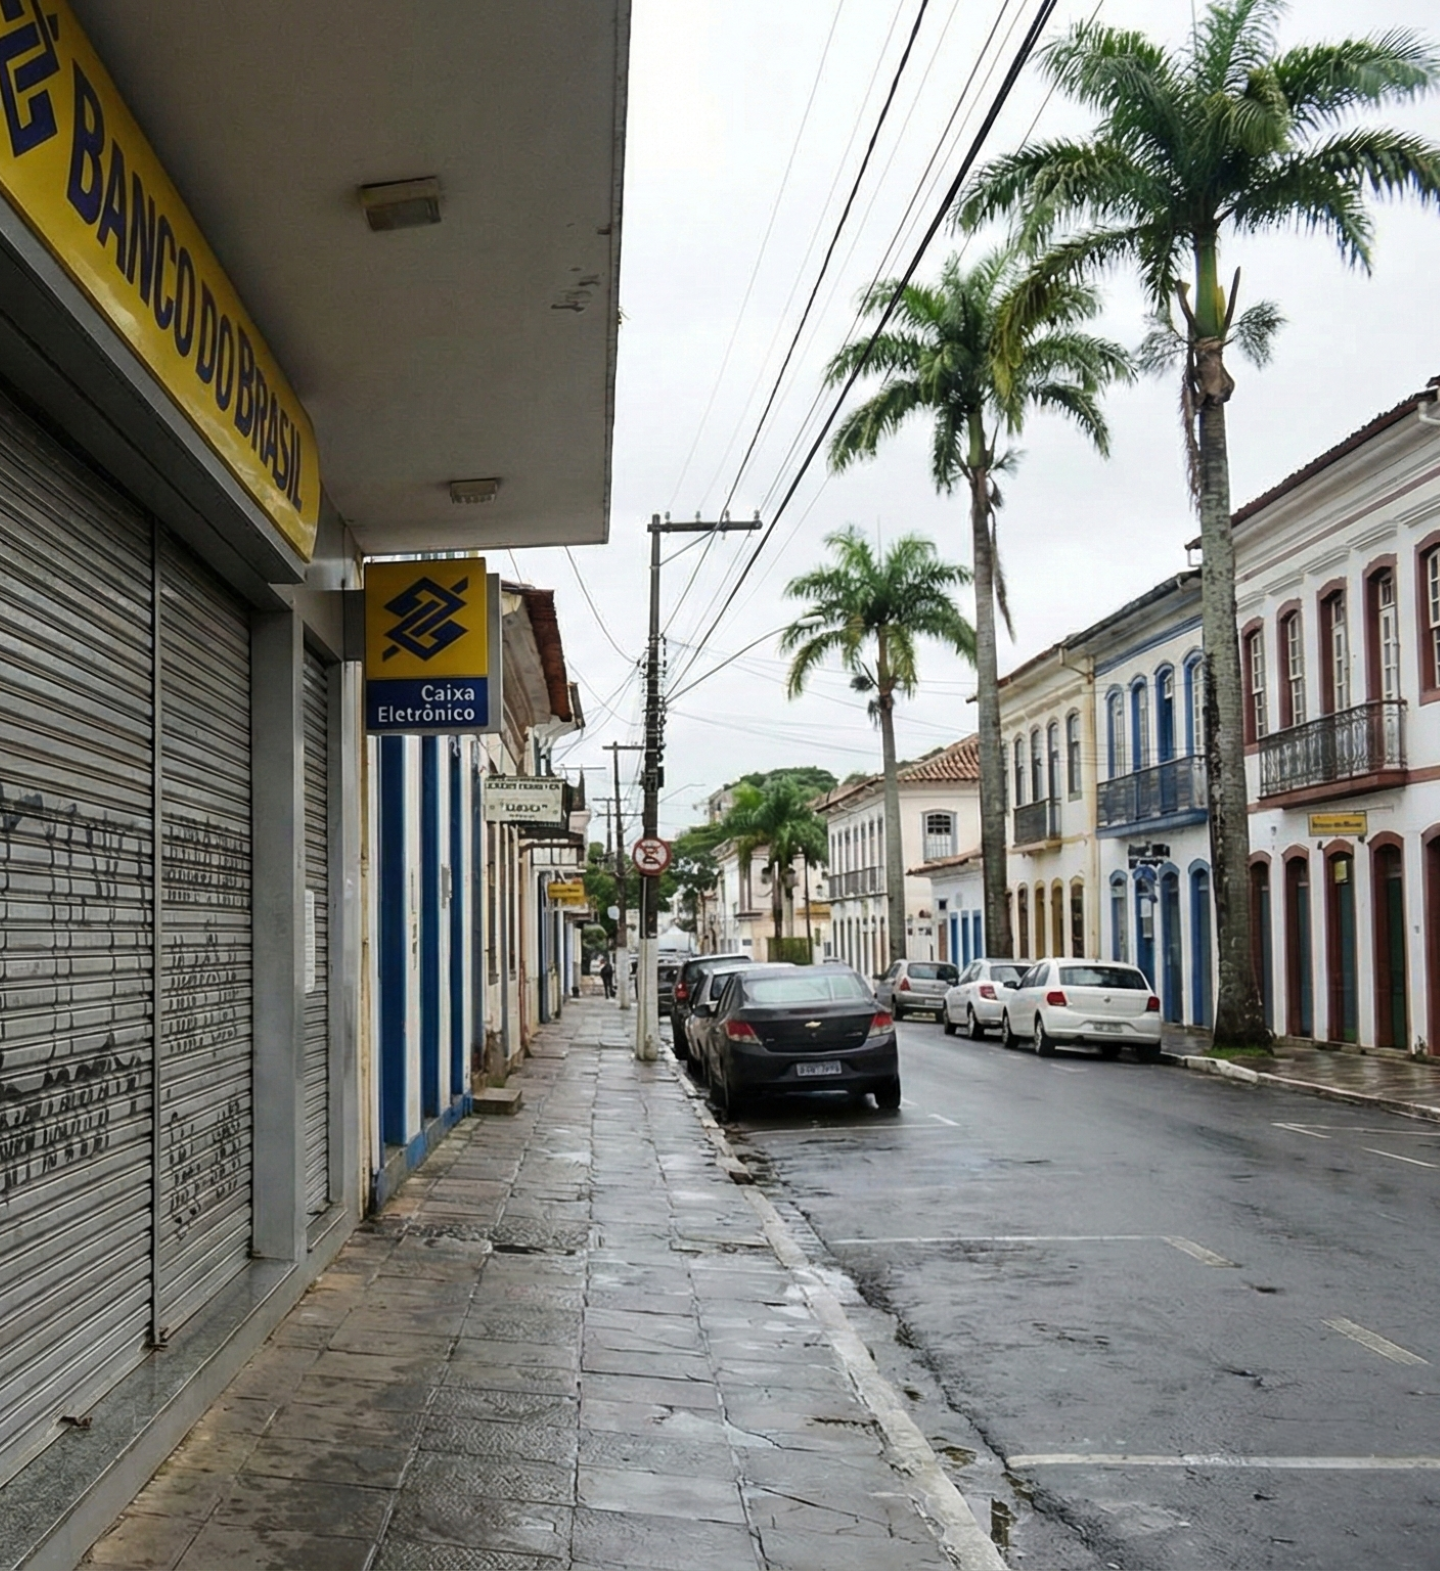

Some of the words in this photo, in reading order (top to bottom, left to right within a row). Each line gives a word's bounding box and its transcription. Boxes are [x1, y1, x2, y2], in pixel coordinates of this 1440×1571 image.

[66, 57, 196, 358] BANCO
[195, 278, 235, 412] DO
[234, 321, 302, 514] BRASIL
[421, 683, 476, 702] Caixa
